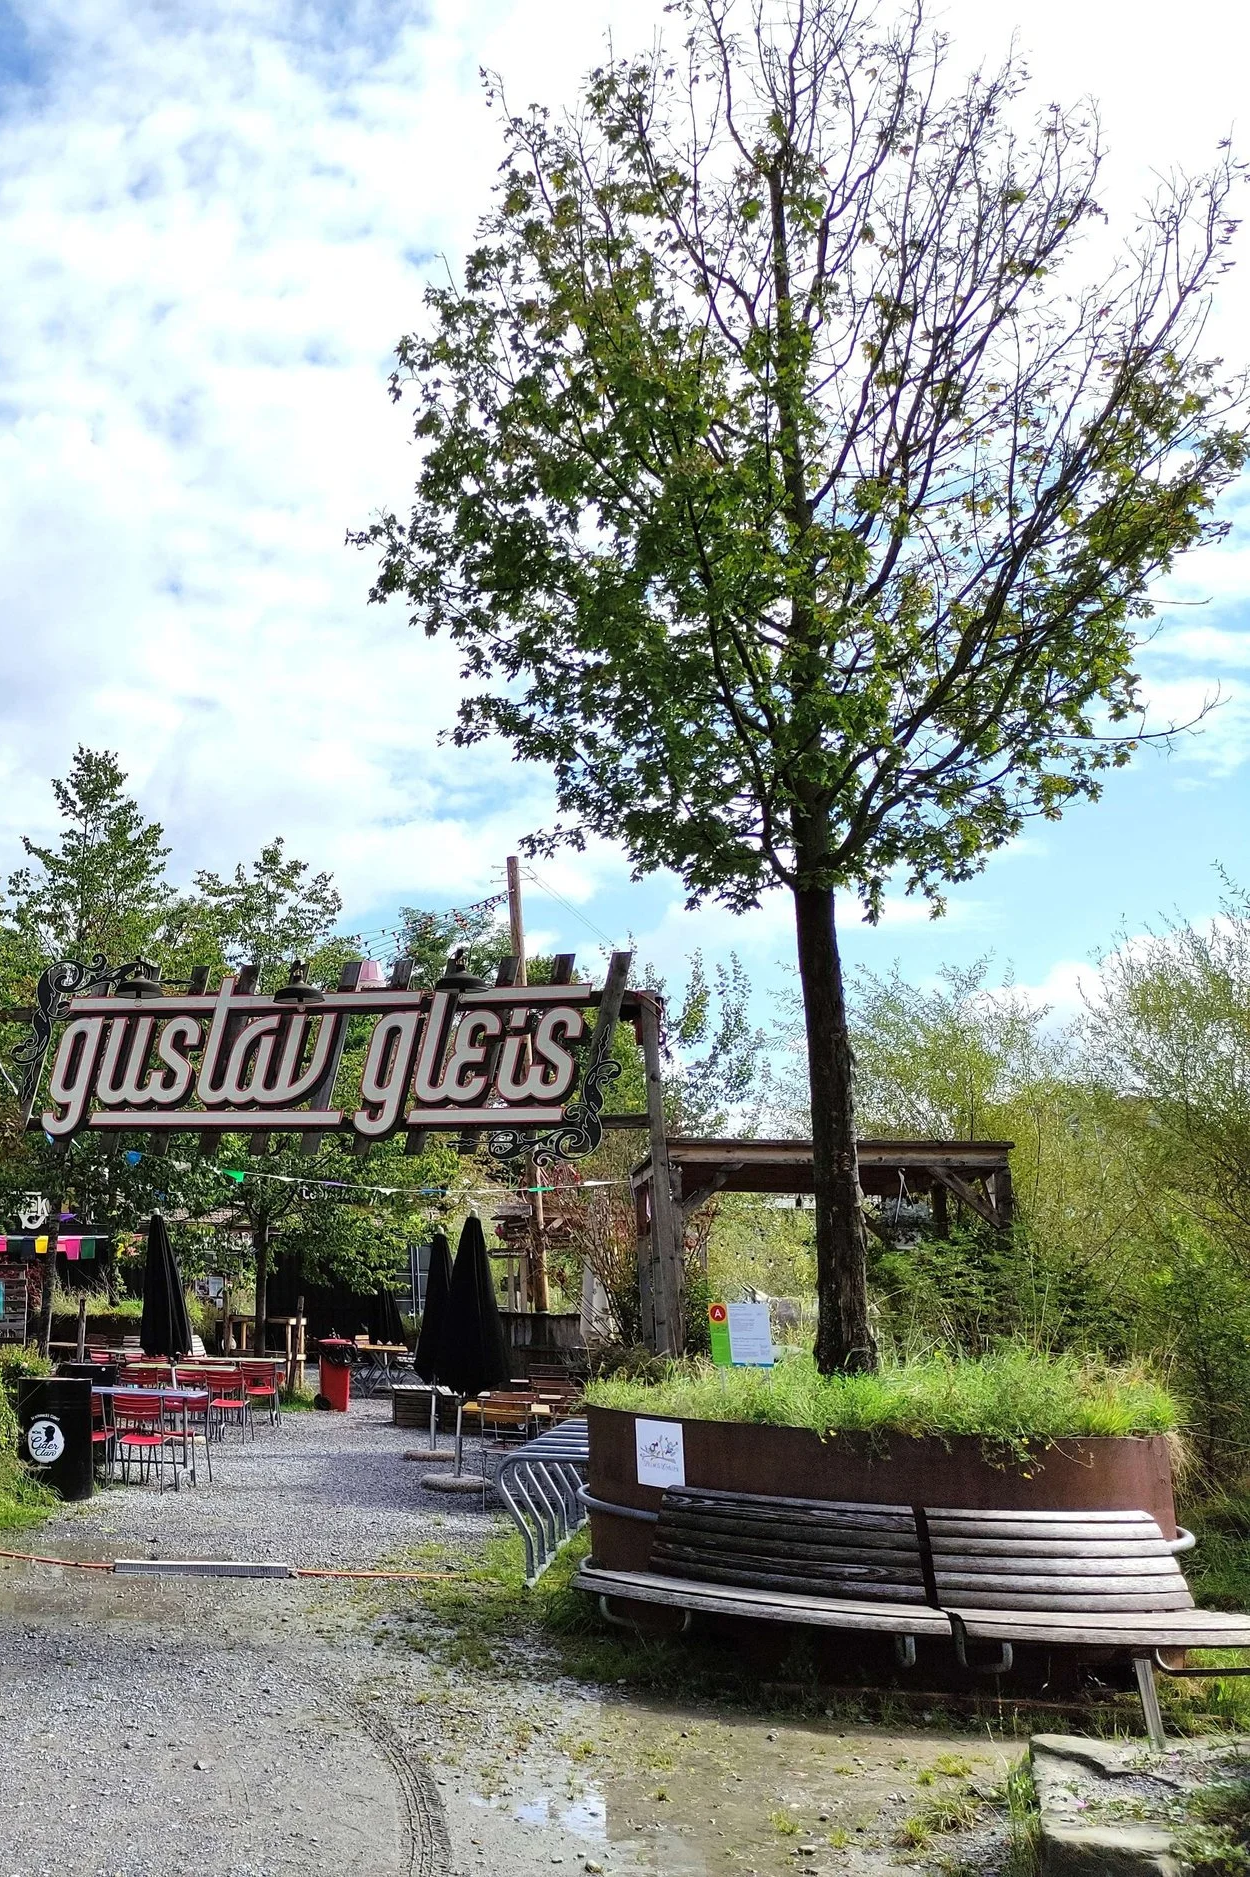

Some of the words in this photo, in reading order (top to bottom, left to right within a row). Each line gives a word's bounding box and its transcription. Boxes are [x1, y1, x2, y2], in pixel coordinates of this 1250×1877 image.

[41, 976, 340, 1140] gustav
[354, 984, 591, 1141] gleis
[714, 1309, 723, 1319] A
[31, 1436, 60, 1450] Cider
[35, 1449, 57, 1457] Clan
